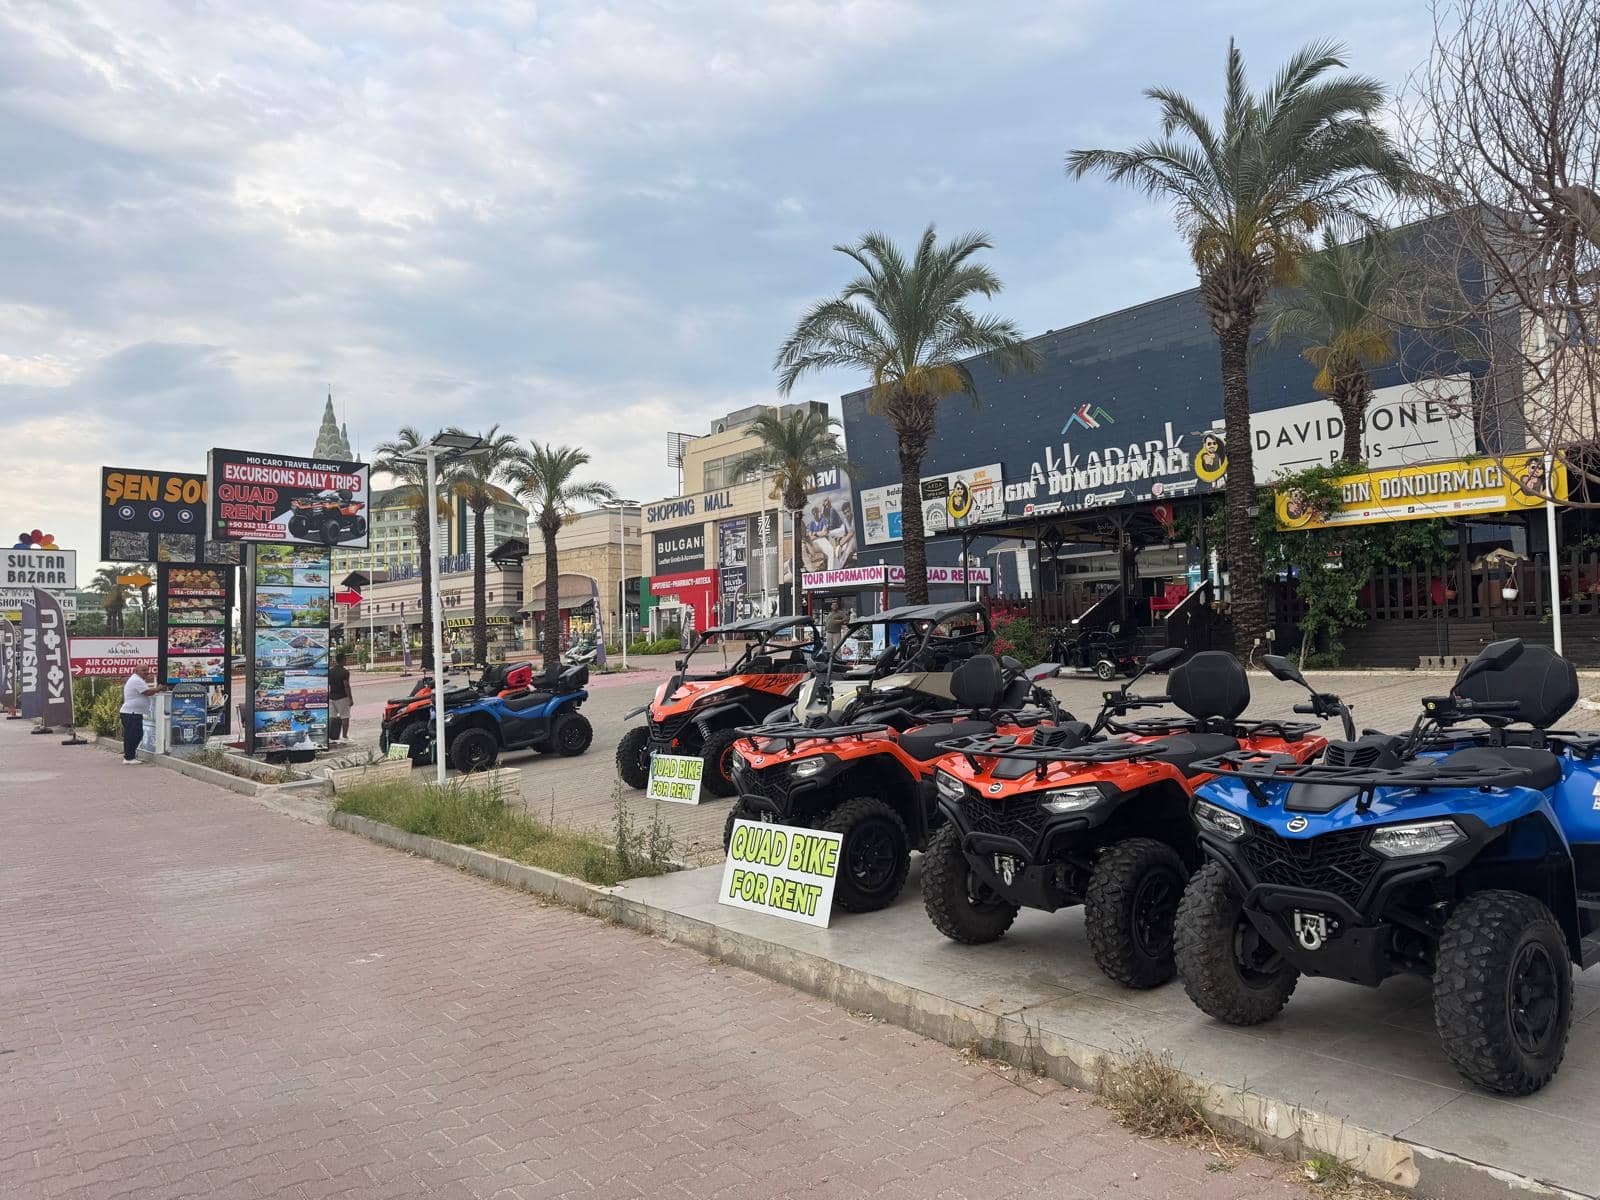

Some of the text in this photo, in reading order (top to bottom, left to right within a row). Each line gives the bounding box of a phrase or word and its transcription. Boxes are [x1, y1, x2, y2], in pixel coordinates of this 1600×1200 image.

[1256, 416, 1343, 451] DAVID
[1330, 443, 1382, 463] PIS
[247, 456, 340, 472] MIO CARO TRAVEL AGENCY
[225, 465, 360, 491] EXCURSIONS DAILY TRIPS
[105, 472, 159, 506] ŞEN
[218, 483, 278, 505] QUAD
[220, 503, 275, 521] RENT
[647, 491, 733, 523] SHOPPING MALL
[7, 554, 65, 569] SULTAN
[7, 570, 66, 584] BAZAAR
[803, 573, 825, 586] TOUR
[826, 567, 883, 583] INFORMATION
[889, 567, 904, 580] CA
[447, 616, 509, 627] DAILY OURS
[84, 667, 117, 675] BAZAAR
[85, 658, 100, 666] AIR
[653, 758, 703, 781] QUAD BIKE
[651, 781, 695, 801] FOR RENT
[731, 825, 839, 878] QUAD BIKE
[729, 868, 823, 916] FOR RENT
